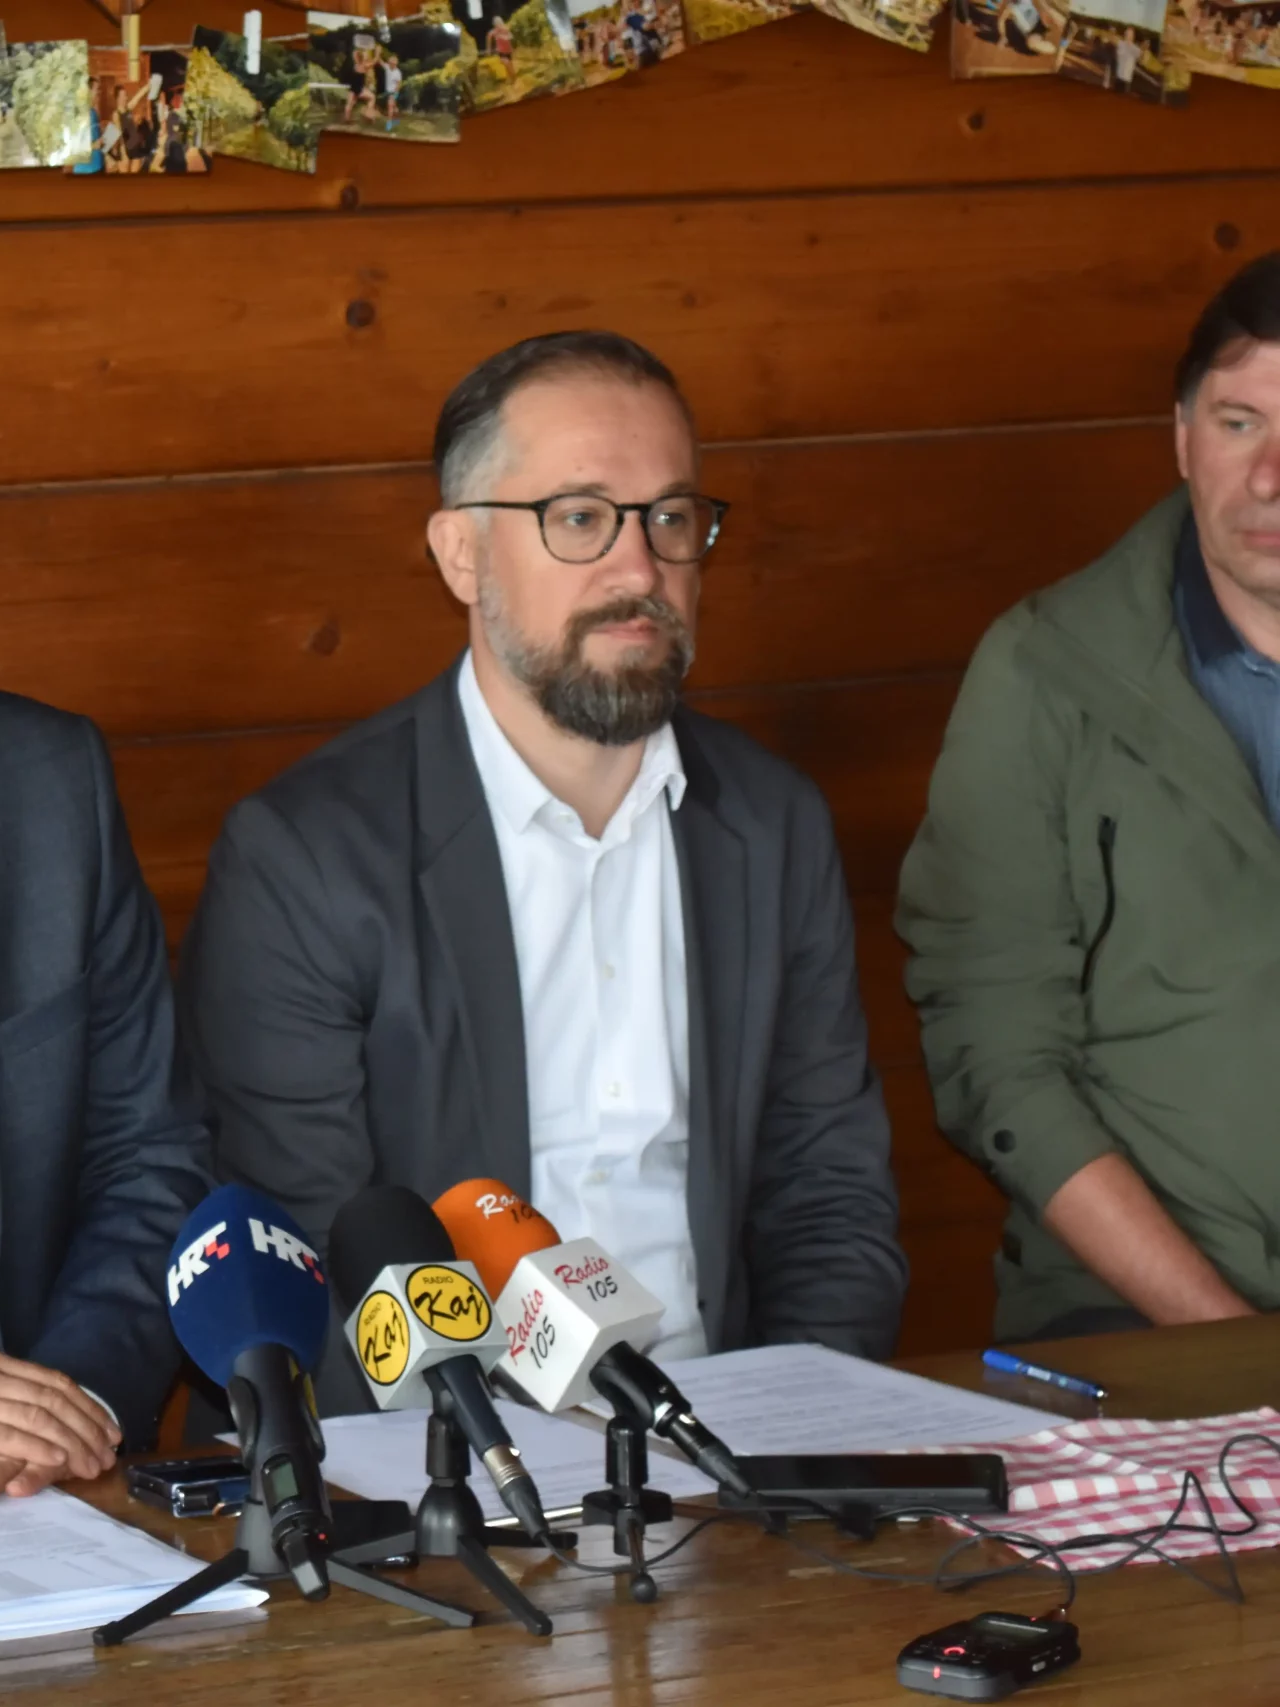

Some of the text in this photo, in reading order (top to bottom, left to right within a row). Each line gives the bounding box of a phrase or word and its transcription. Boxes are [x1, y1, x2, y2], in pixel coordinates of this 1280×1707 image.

[167, 1221, 230, 1307] HRT
[248, 1217, 324, 1284] HRT
[554, 1256, 609, 1288] Radio
[415, 1285, 484, 1326] Kaj
[422, 1276, 454, 1284] RADIO
[587, 1276, 618, 1301] 105
[364, 1300, 405, 1378] Kaj
[506, 1289, 543, 1367] Radio
[530, 1314, 555, 1369] 105
